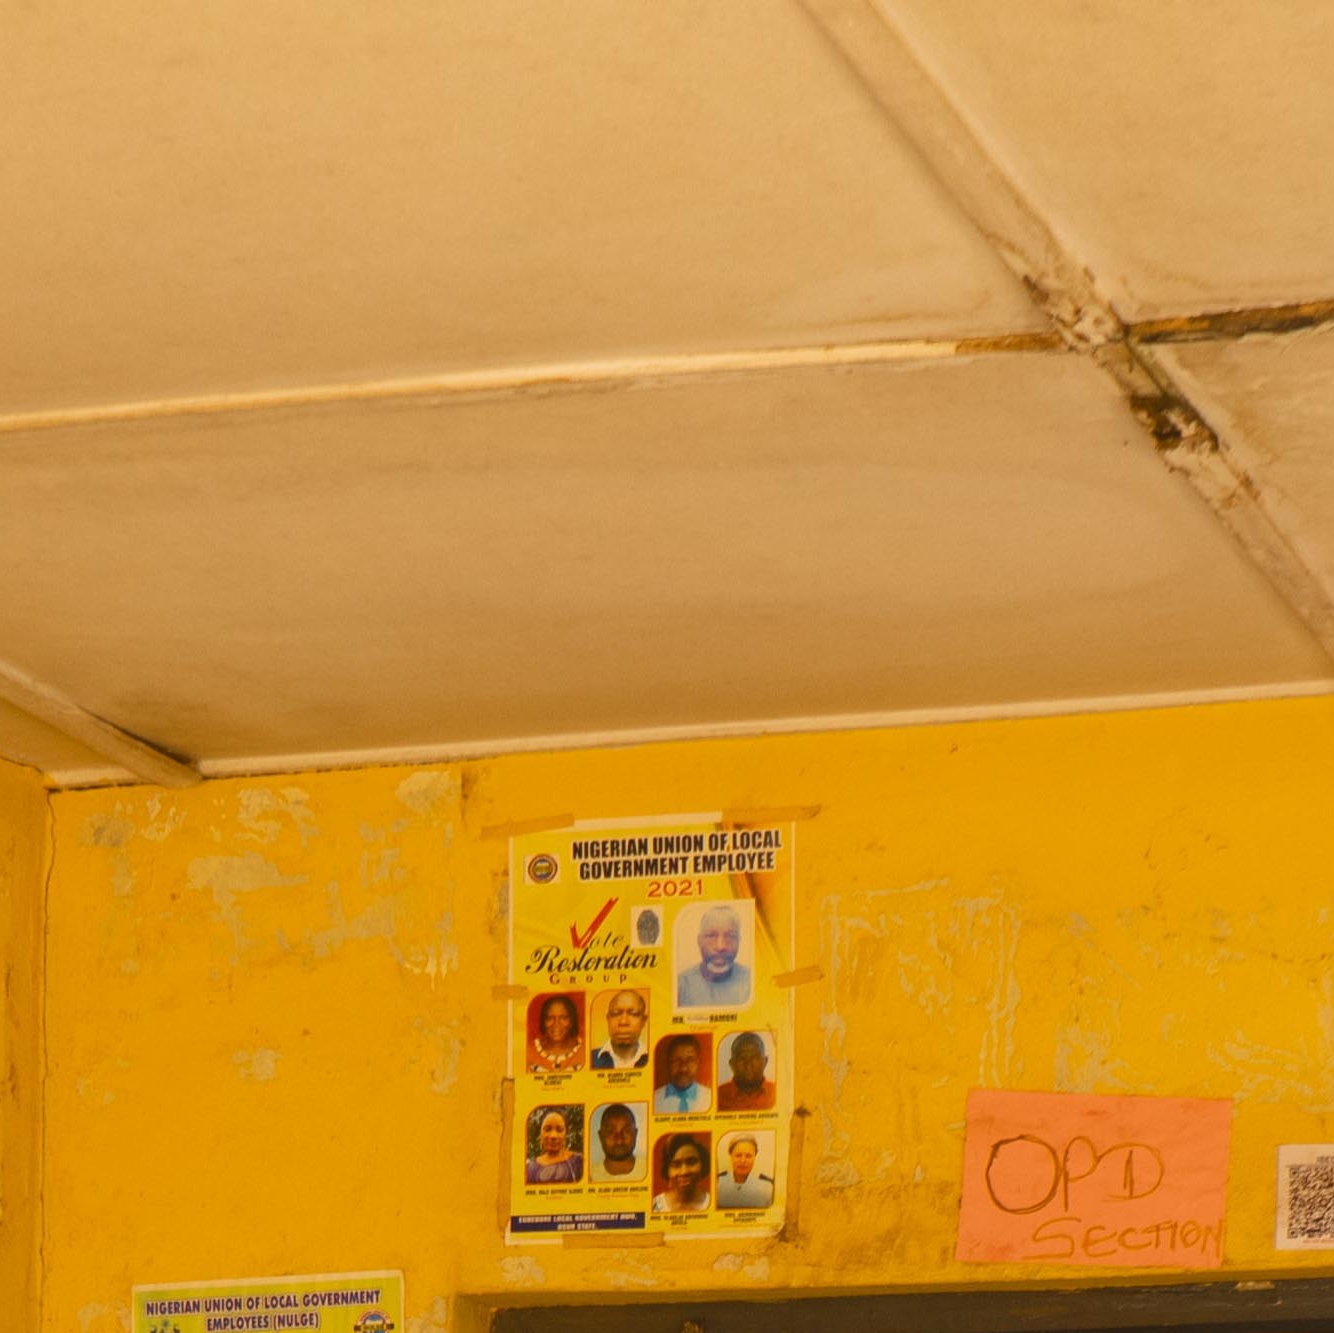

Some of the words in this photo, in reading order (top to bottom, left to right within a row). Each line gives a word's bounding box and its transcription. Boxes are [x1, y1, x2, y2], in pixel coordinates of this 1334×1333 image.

[573, 838, 648, 861] NIGERIAN
[653, 834, 704, 855] UNION
[708, 832, 728, 851] OF
[732, 830, 781, 850] LOCAL
[580, 856, 688, 880] GOVERNMENT
[693, 851, 774, 874] EMPLOYEE
[647, 880, 704, 898] 2021
[525, 945, 657, 974] Restoration
[985, 1134, 1164, 1215] OPD
[1022, 1217, 1223, 1258] SECTION
[146, 1300, 200, 1316] NIGERIAN
[204, 1297, 242, 1313] UNION
[246, 1296, 260, 1310] OF
[264, 1293, 299, 1309] LOCAL
[302, 1290, 380, 1307] GOVERNMENT
[206, 1314, 270, 1332] EMPLOYEES
[273, 1311, 321, 1332] (NULGE)
